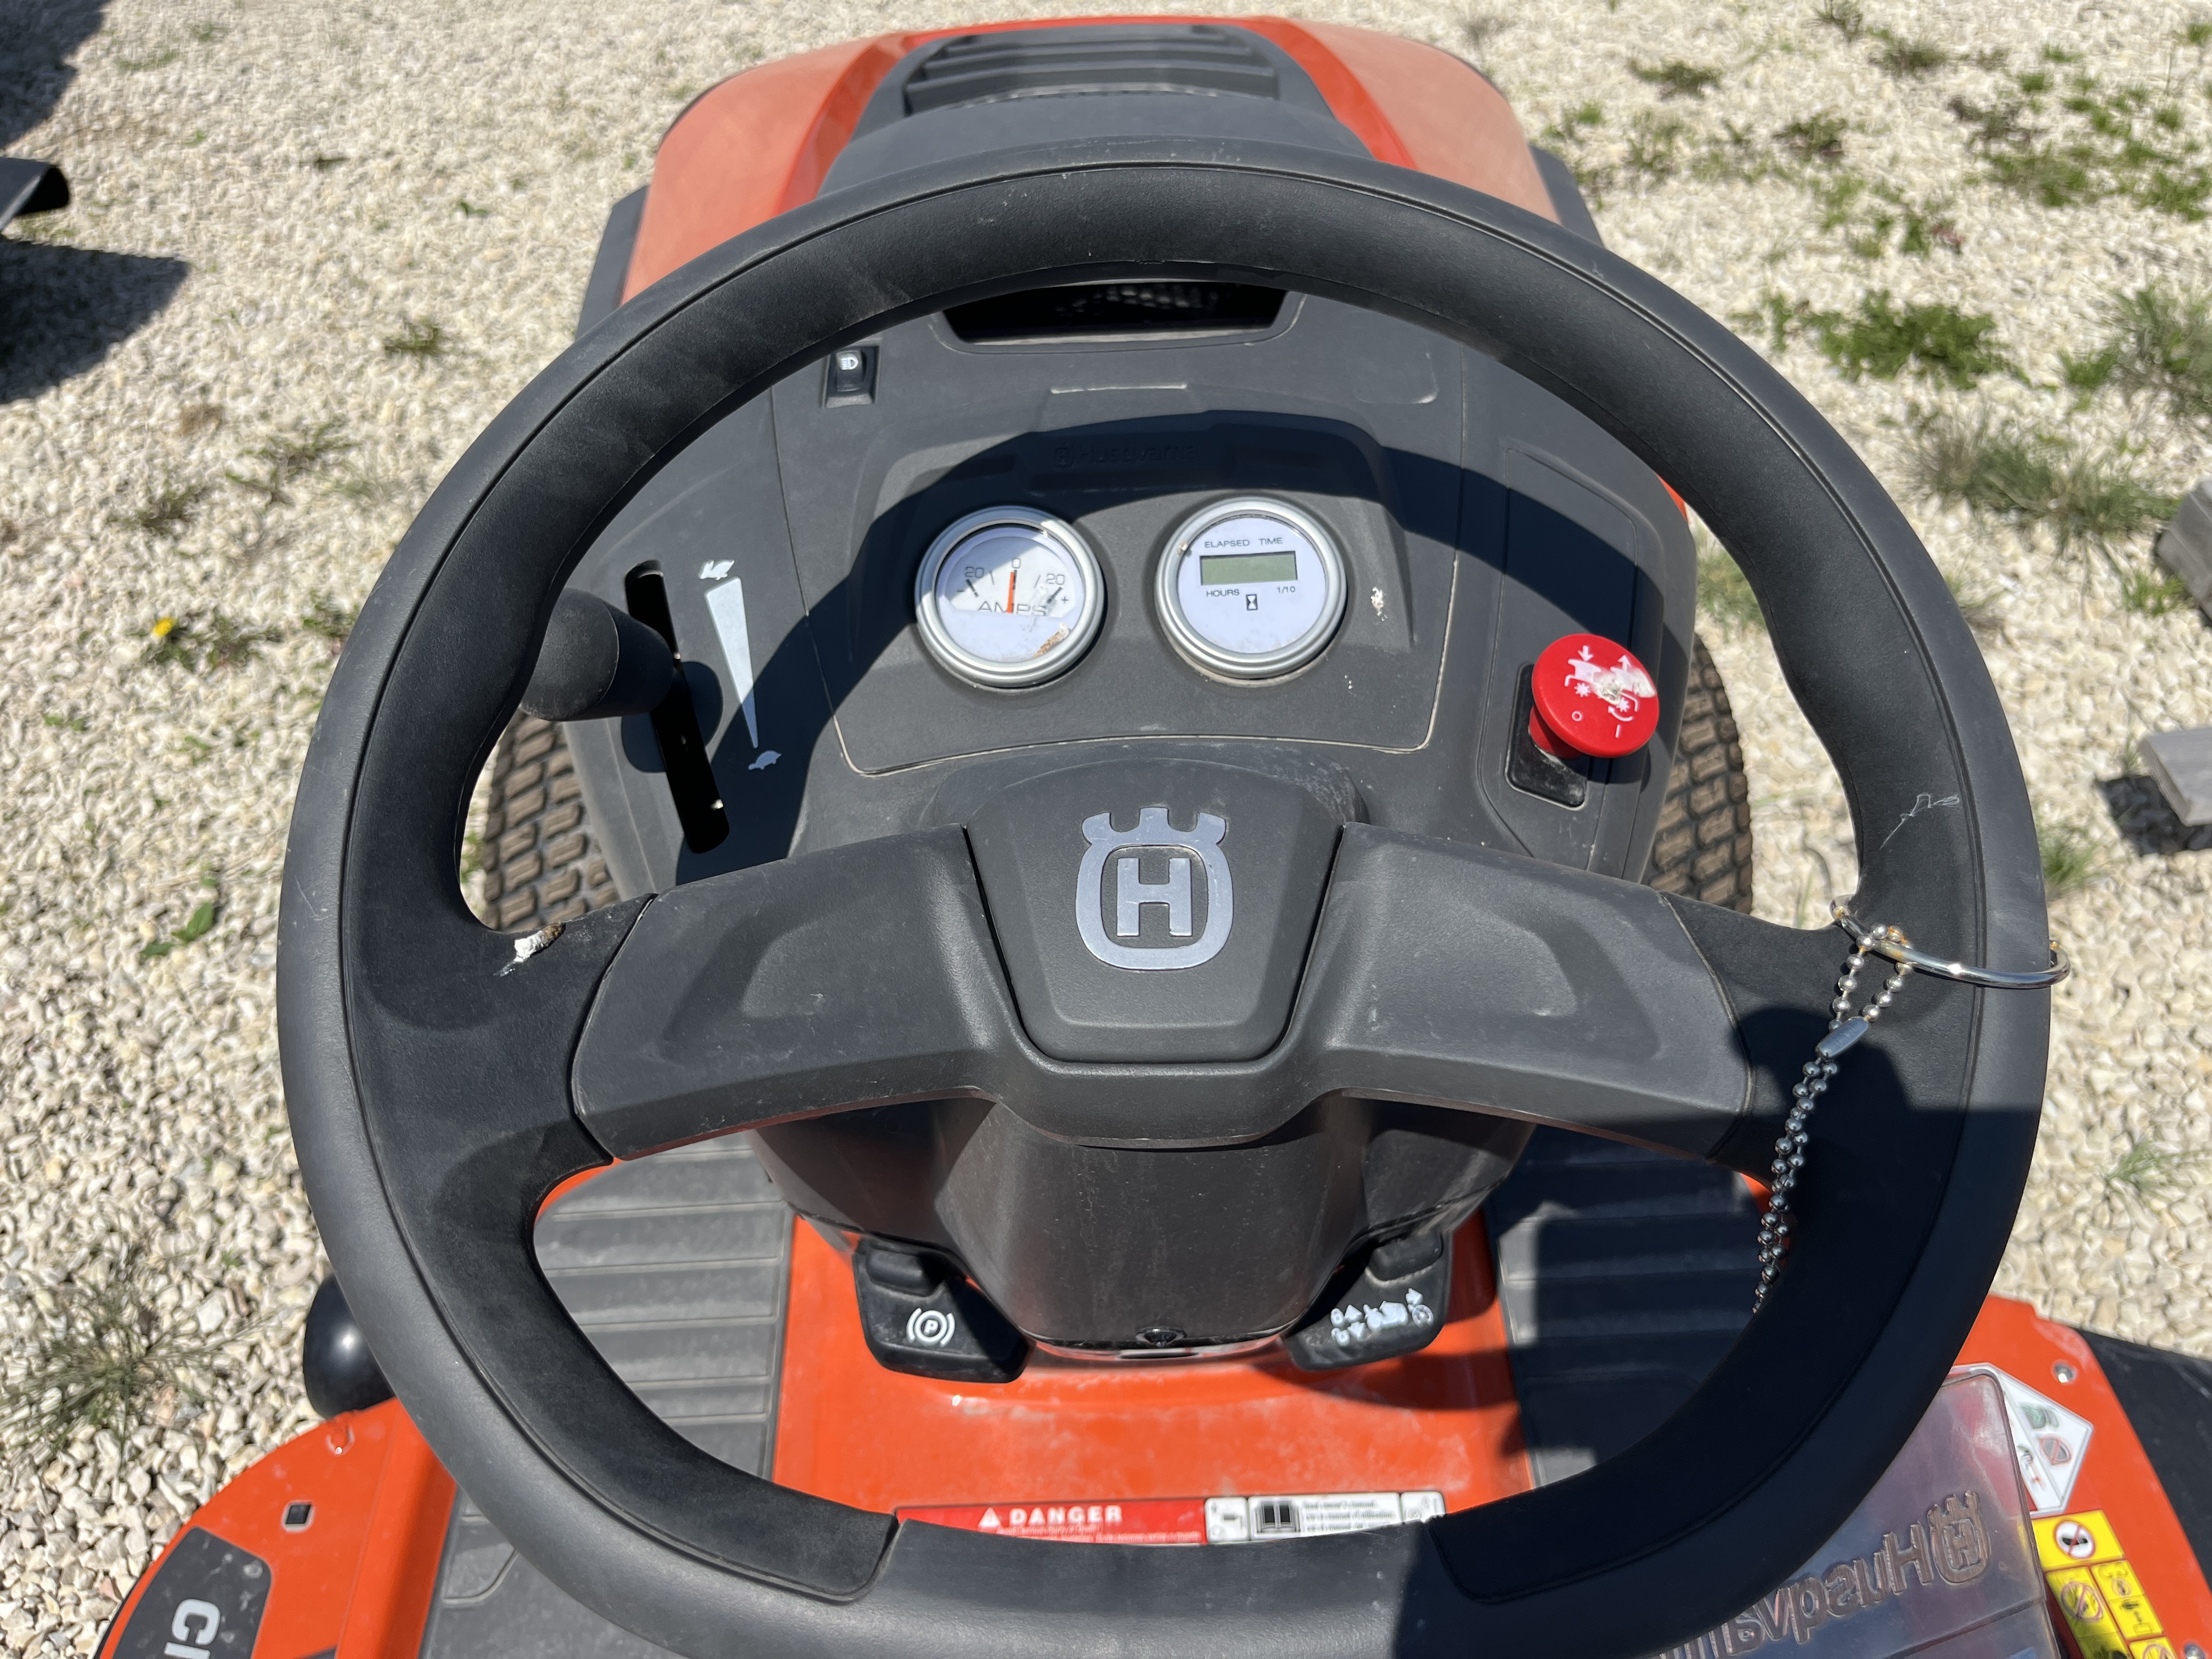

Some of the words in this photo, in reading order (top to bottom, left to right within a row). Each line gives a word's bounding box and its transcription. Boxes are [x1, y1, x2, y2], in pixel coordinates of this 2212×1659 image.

[1205, 539, 1250, 548] ELAPSED
[1012, 558, 1021, 568] 0
[965, 566, 984, 578] 20
[1046, 573, 1065, 585] 20
[1206, 589, 1240, 597] HOURS
[1277, 586, 1296, 594] 1/10
[978, 601, 1046, 617] AMPS
[1009, 1505, 1122, 1526] DANGER
